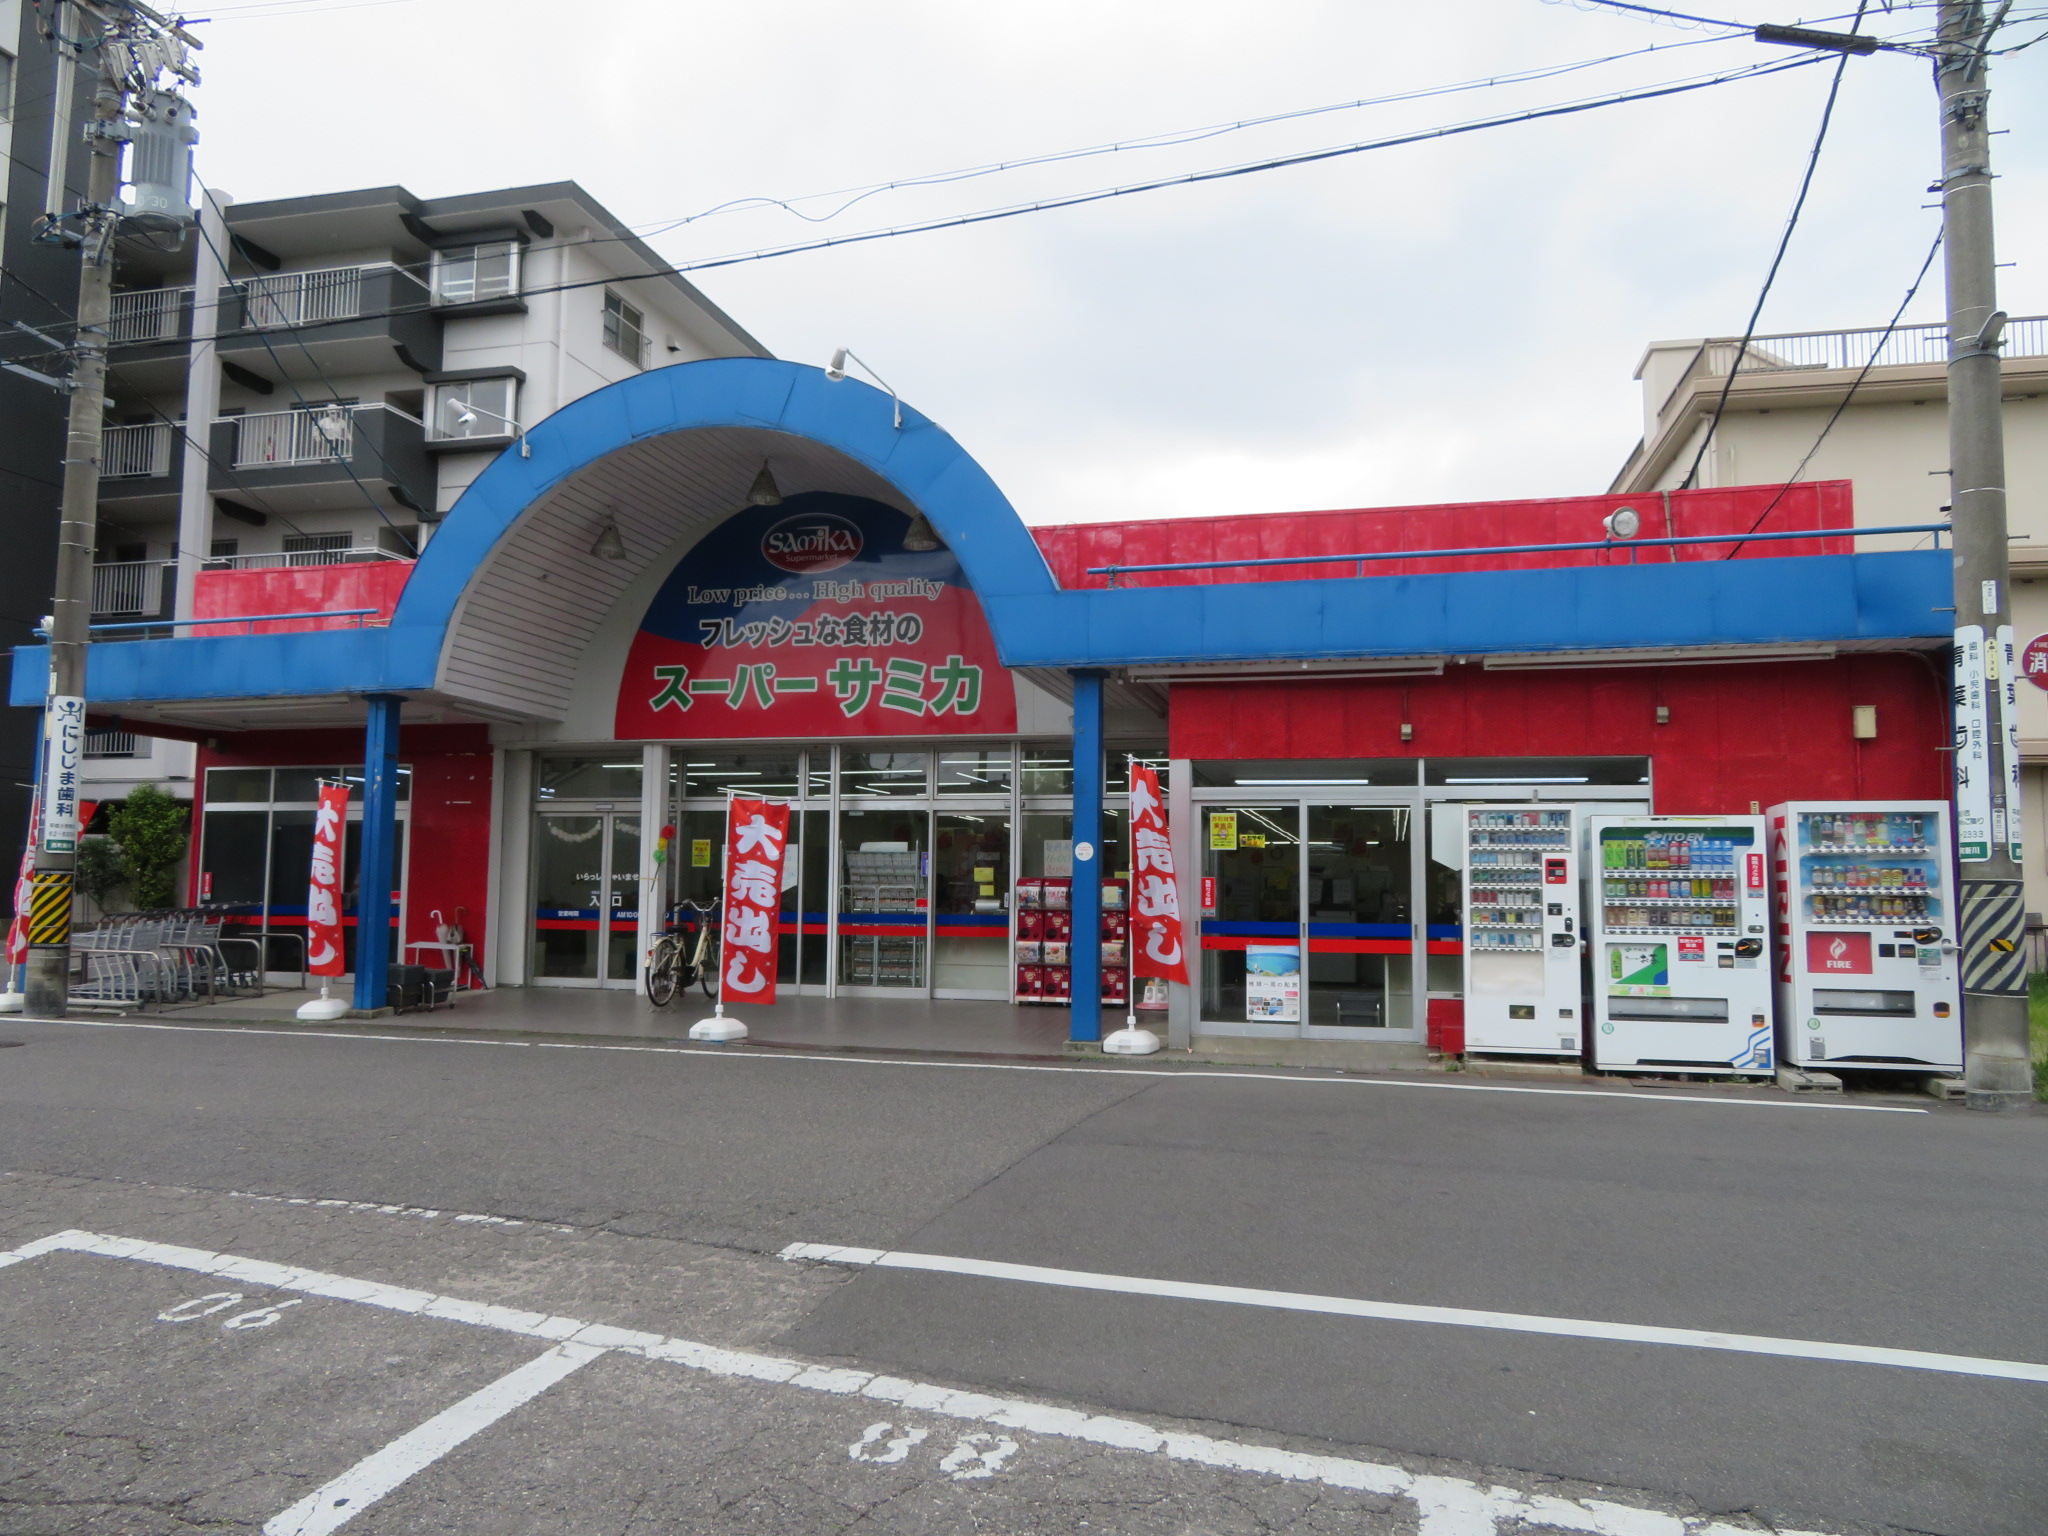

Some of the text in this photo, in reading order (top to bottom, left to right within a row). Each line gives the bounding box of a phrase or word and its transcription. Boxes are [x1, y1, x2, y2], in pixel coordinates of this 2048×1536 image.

[786, 553, 838, 563] Supermarket
[687, 585, 731, 604] Low
[813, 580, 865, 603] High
[869, 578, 945, 601] quality
[699, 611, 923, 649] フレッシュな食材の
[648, 654, 984, 717] スーパー サミカ
[55, 724, 79, 817] にしじま歯科
[1132, 778, 1182, 966] 大売出し
[589, 895, 623, 907] 入口
[726, 814, 783, 993] 大売出し
[1773, 816, 1793, 983] KIRIN
[1827, 960, 1852, 969] FIRE
